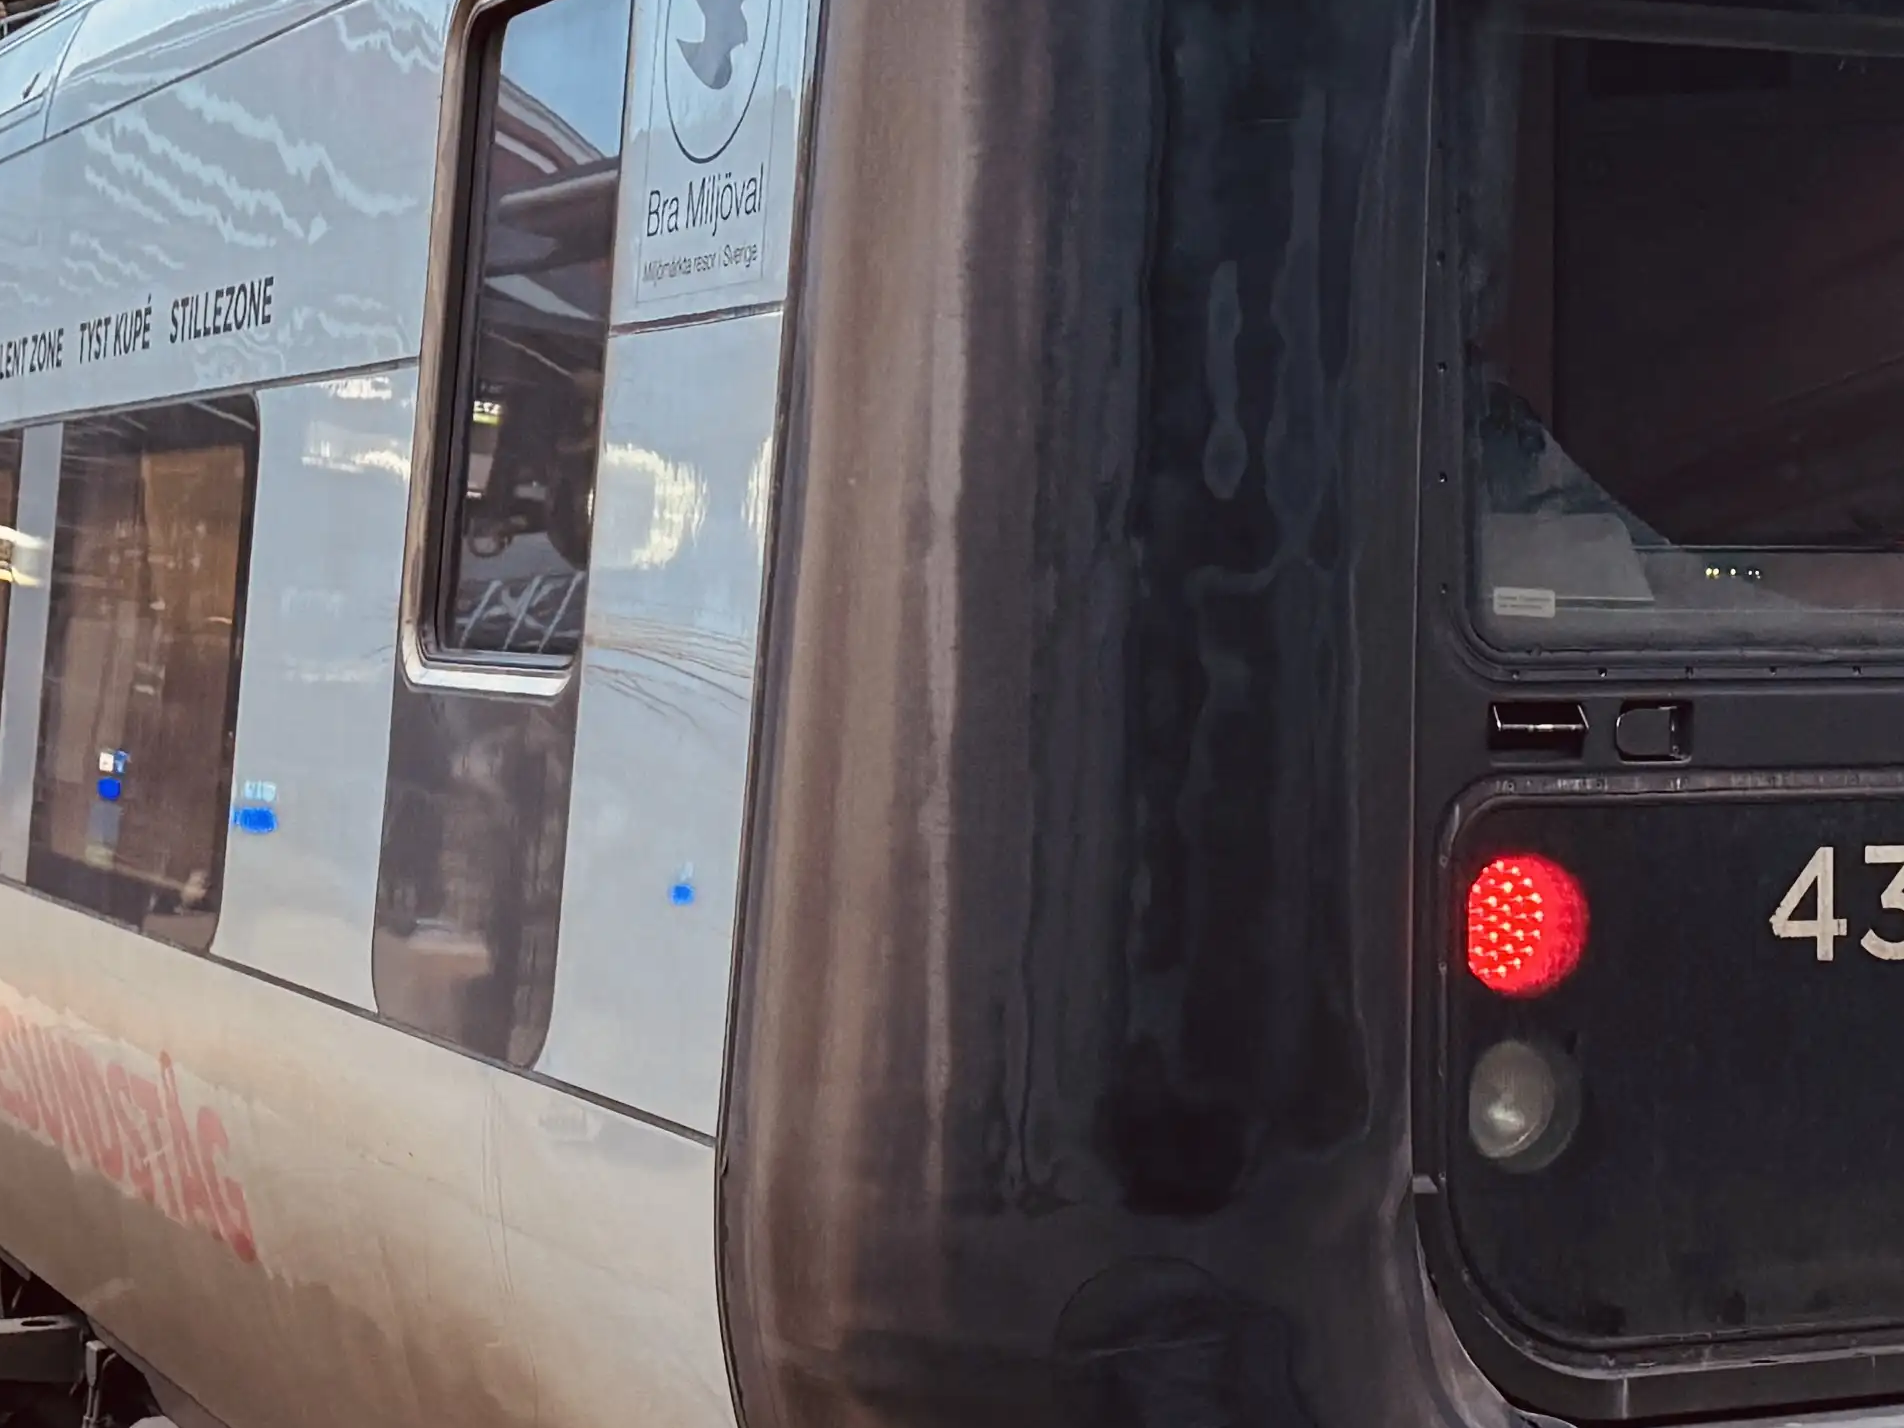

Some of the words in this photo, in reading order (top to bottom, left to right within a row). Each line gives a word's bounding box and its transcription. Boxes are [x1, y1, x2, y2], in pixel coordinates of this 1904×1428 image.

[646, 189, 679, 238] Bra
[686, 162, 764, 238] Miljöval
[28, 327, 65, 373] ZONE
[79, 316, 113, 365] TYST
[113, 293, 153, 358] KUPÉ
[169, 275, 275, 344] STILLEZONE
